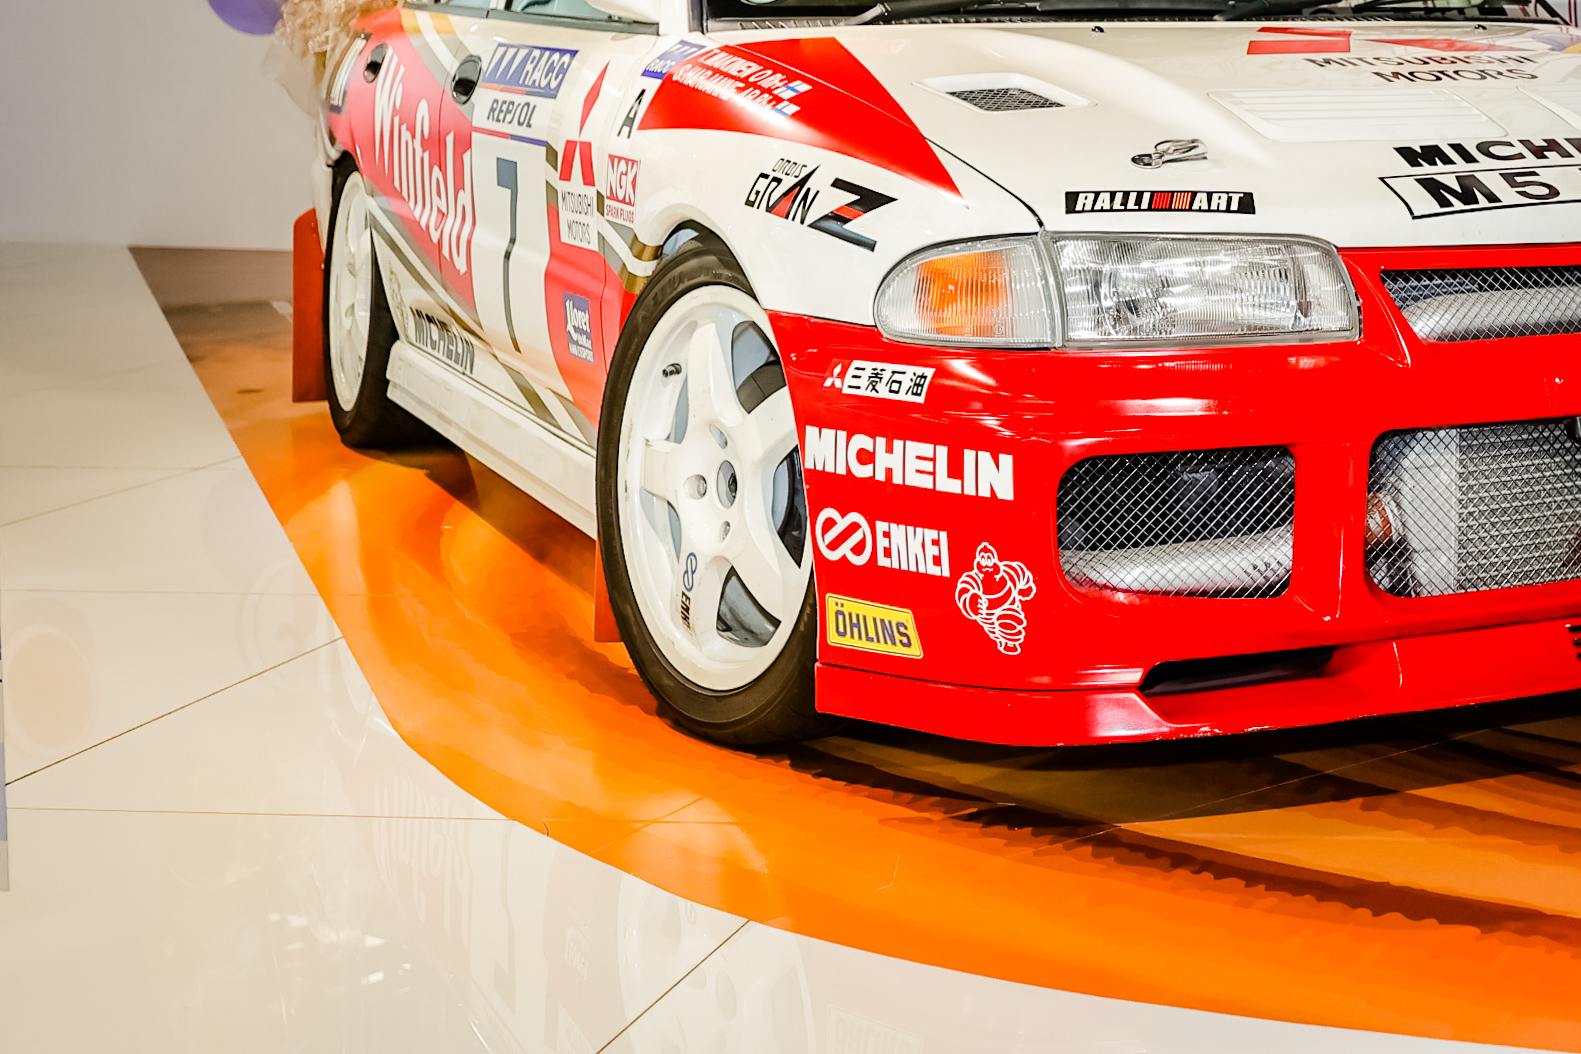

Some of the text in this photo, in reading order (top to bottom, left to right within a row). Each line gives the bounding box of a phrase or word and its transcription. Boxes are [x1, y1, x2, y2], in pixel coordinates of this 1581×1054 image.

[519, 49, 571, 90] RACC
[1304, 54, 1539, 69] MITSUBISHI
[1372, 68, 1540, 83] MOTORS
[487, 98, 537, 129] REPSOL
[617, 89, 647, 140] A
[374, 45, 476, 275] Winfield
[772, 158, 808, 179] ORBIS
[606, 156, 638, 206] NGK
[1414, 169, 1561, 209] M5
[561, 189, 595, 219] MITSUBISHI
[605, 204, 635, 224] SPARK PLUGS
[1075, 192, 1244, 211] RALLI ART
[567, 218, 592, 246] MOTORS
[495, 156, 522, 355] 7
[409, 306, 475, 375] MICHELIN
[847, 366, 929, 398] 三菱石油
[804, 425, 1015, 502] MICHELIN
[875, 520, 951, 578] ENKEI
[833, 601, 913, 649] ÖHLINS
